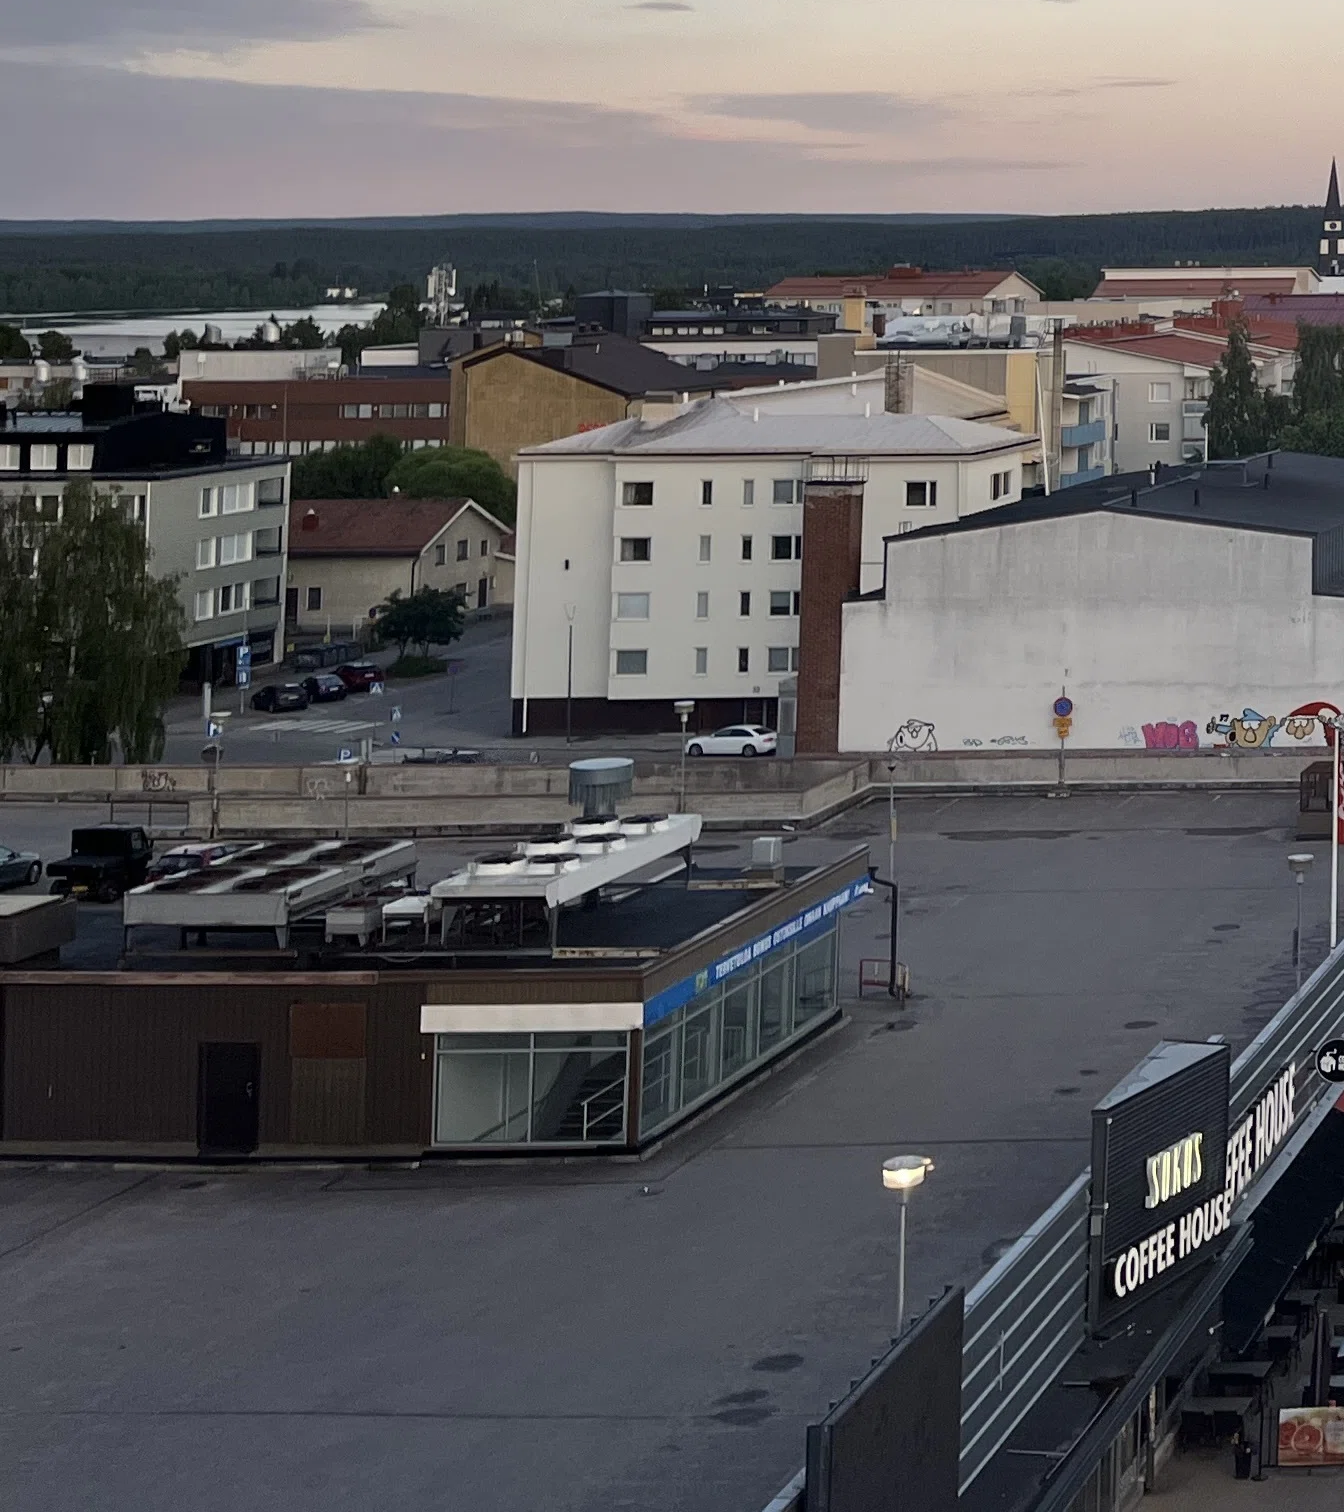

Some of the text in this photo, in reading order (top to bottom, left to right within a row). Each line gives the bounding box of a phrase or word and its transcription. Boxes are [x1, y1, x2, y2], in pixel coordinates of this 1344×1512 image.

[1145, 1132, 1203, 1208] SOKOS
[1254, 1060, 1296, 1174] HOUSE
[1114, 1188, 1233, 1298] COFFEE HOUSE
